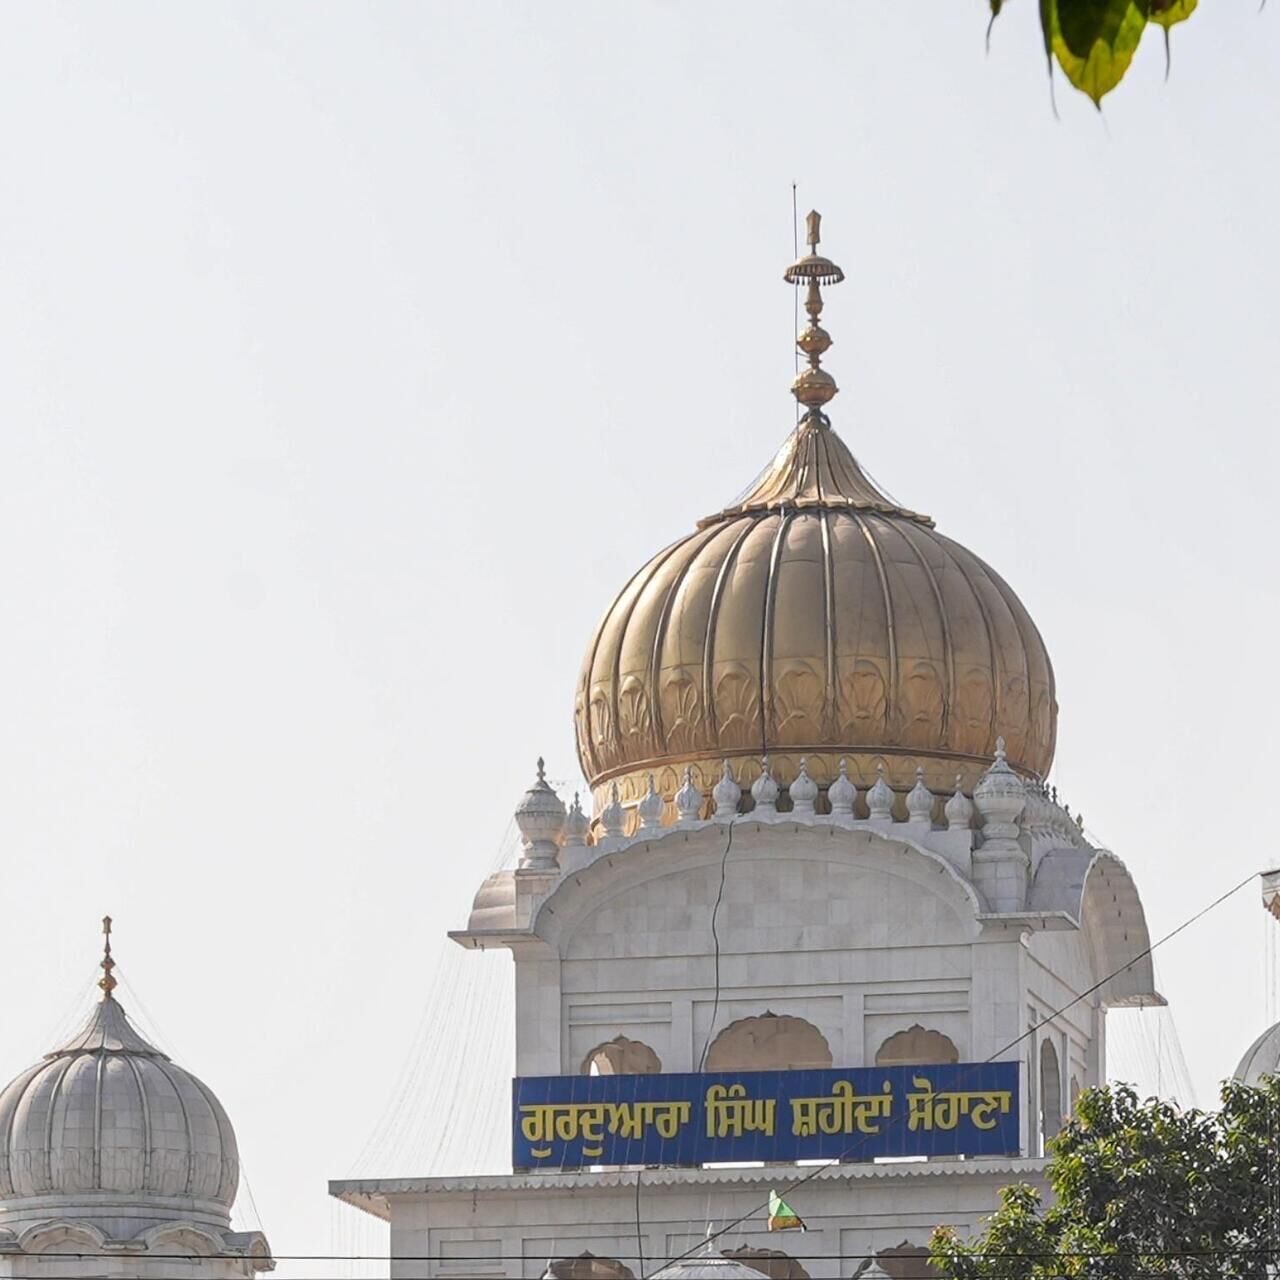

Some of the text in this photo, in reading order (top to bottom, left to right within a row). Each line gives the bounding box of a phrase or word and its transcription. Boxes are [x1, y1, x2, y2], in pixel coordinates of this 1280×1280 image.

[519, 1076, 1012, 1157] ਗੁਰਦੁਆਰਾ ਸਿੰਘ ਸ਼ਹੀਦਾਂ ਸੋਹਾਣਾ
